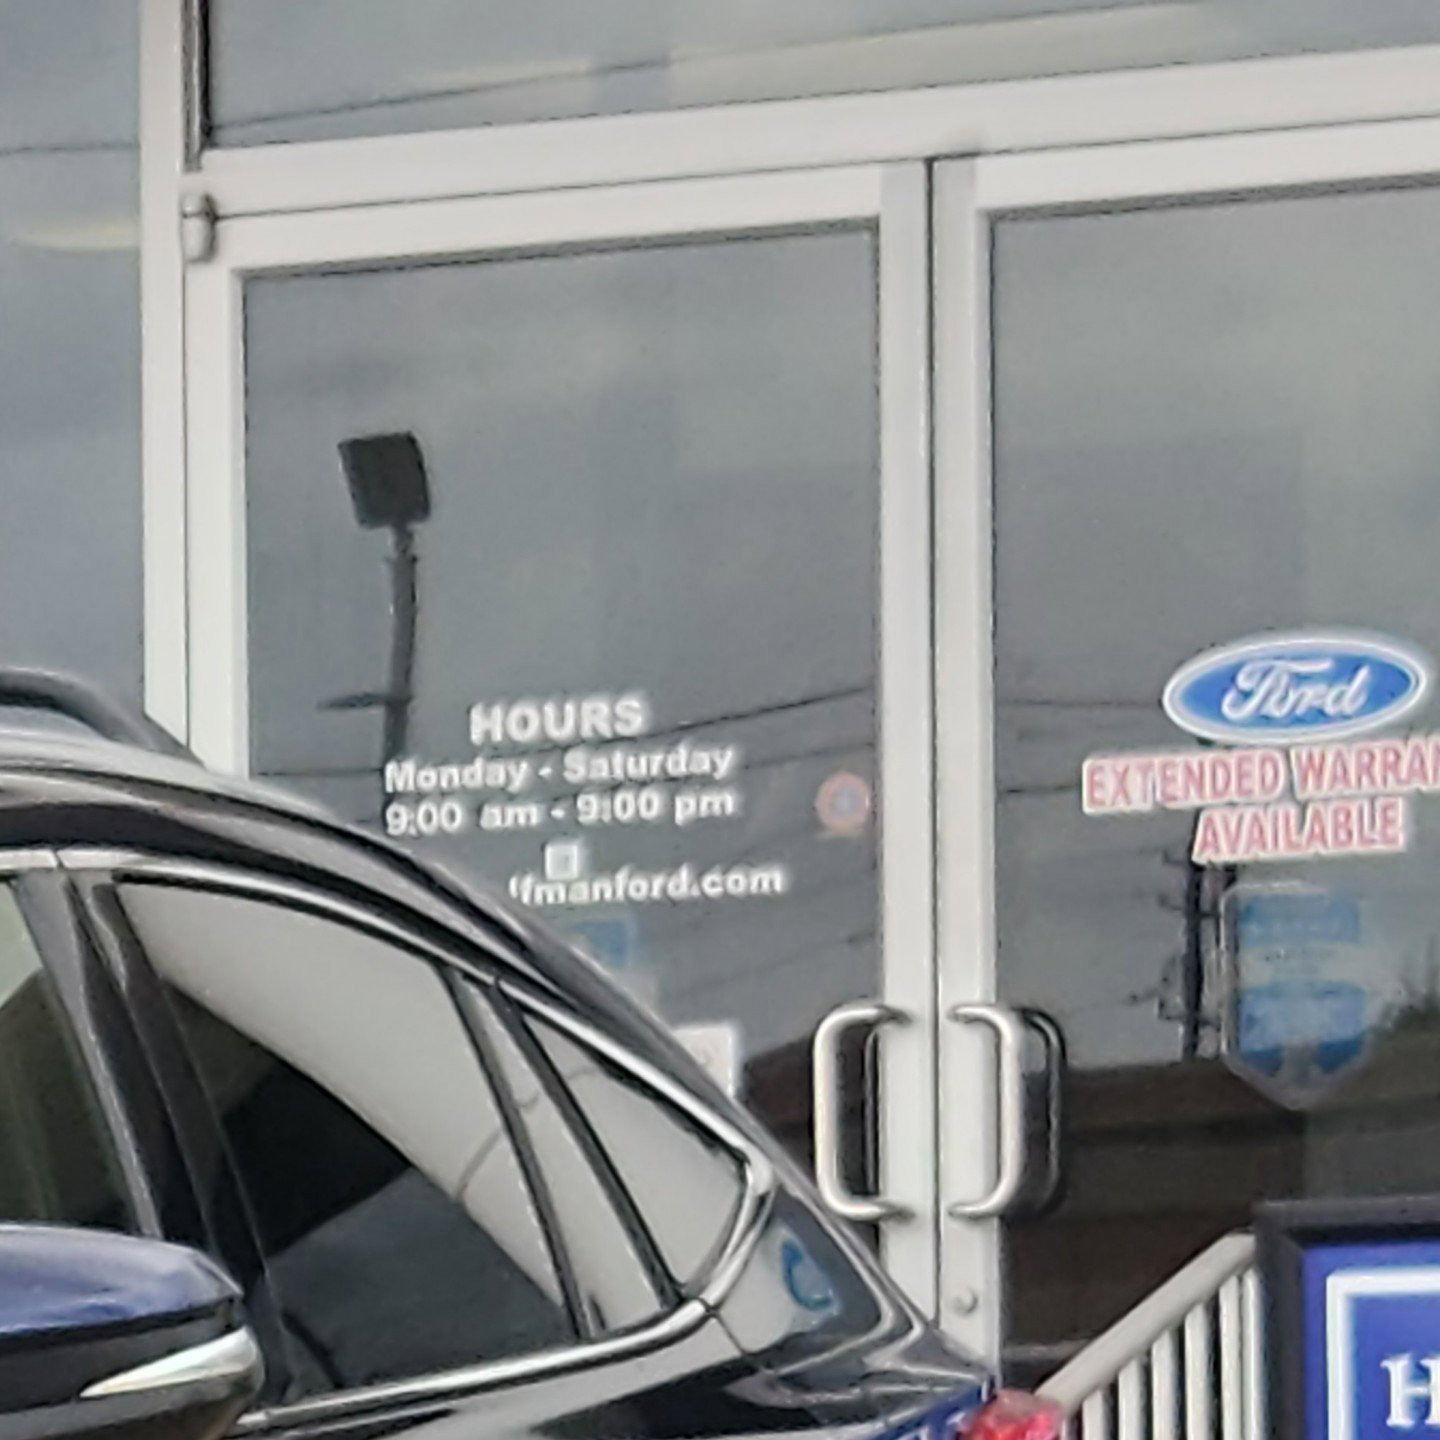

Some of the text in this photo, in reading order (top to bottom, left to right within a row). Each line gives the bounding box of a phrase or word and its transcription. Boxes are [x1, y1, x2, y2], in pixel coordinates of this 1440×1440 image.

[1221, 657, 1370, 722] Ford
[470, 697, 646, 744] HOURS
[384, 757, 528, 793] Monday
[563, 743, 734, 783] Saturday
[1085, 748, 1282, 810] EXTENDED
[385, 800, 462, 835] 9:00
[480, 803, 538, 829] am
[576, 789, 661, 825] 9:00
[674, 787, 735, 824] pm
[1195, 799, 1403, 858] AVAILABLE
